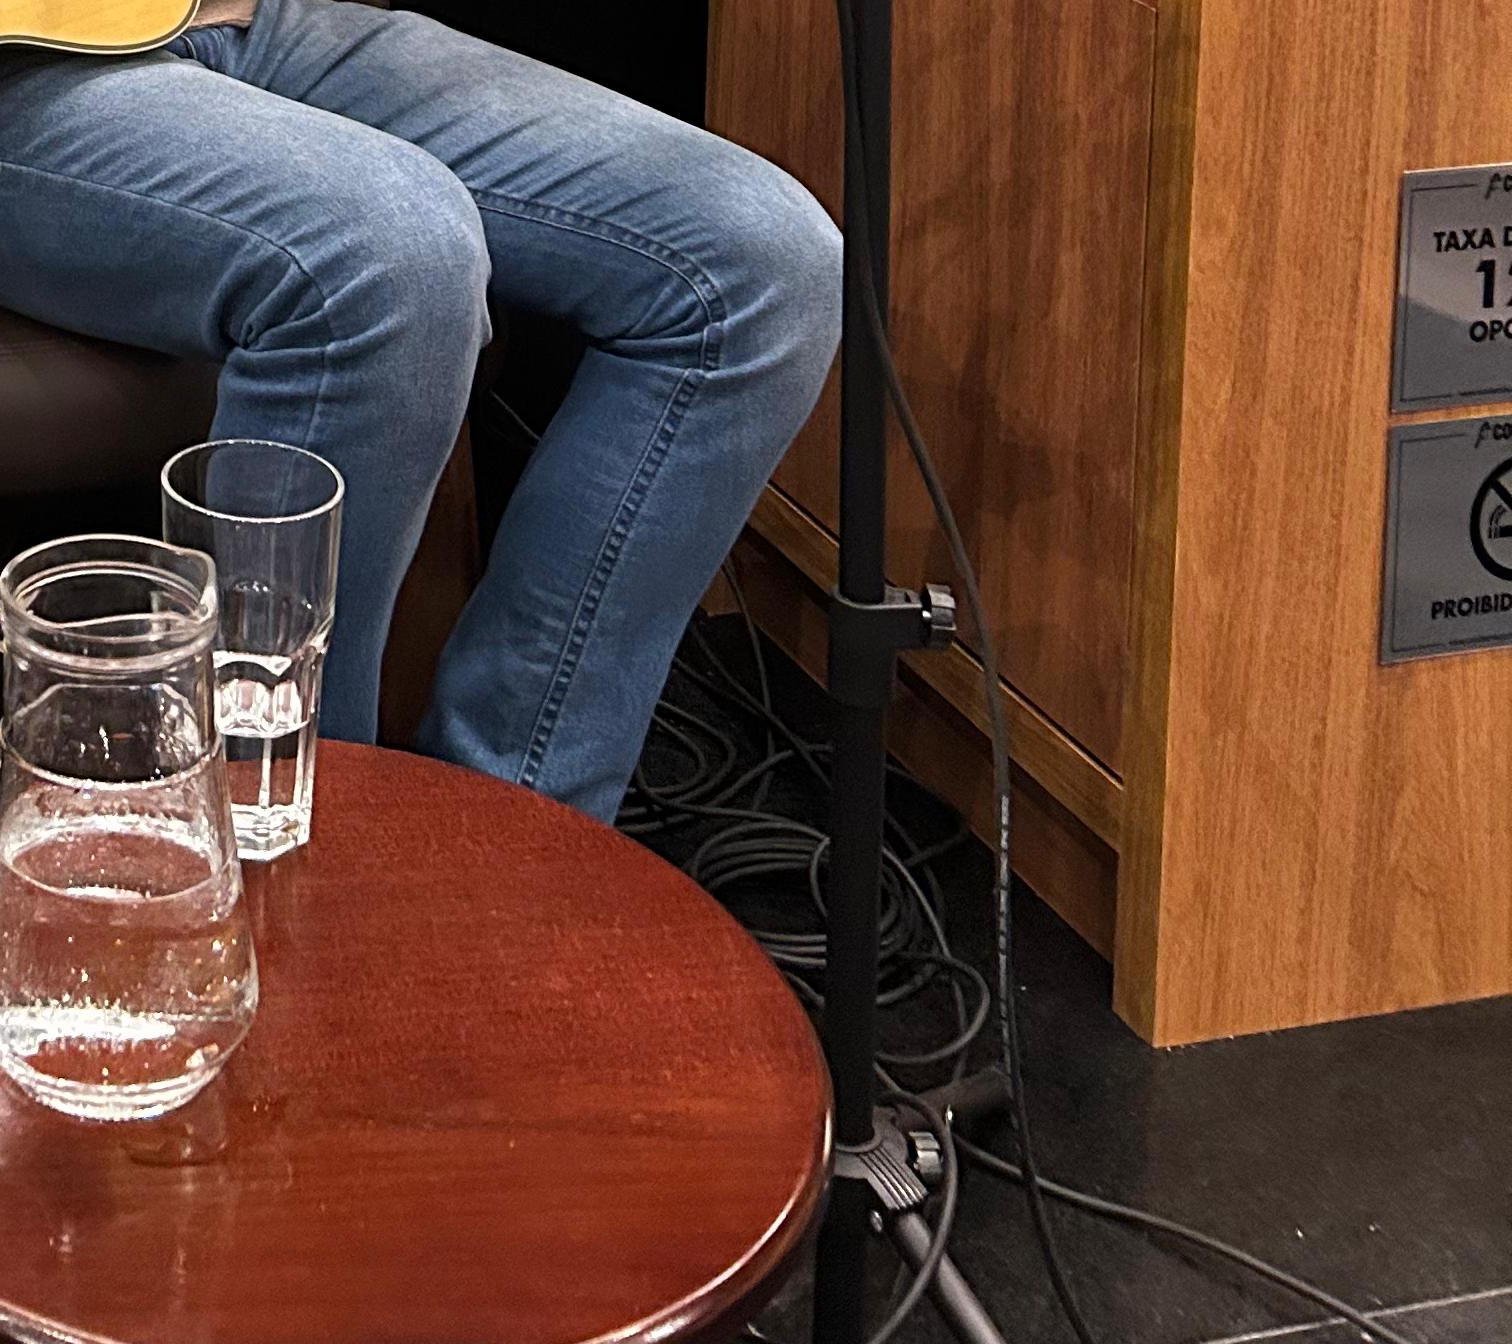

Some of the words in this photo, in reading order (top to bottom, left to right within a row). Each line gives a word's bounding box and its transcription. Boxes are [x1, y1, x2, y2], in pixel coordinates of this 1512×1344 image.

[1433, 227, 1496, 252] TAXA
[1475, 259, 1512, 309] 1
[1431, 592, 1512, 620] PROIBID
